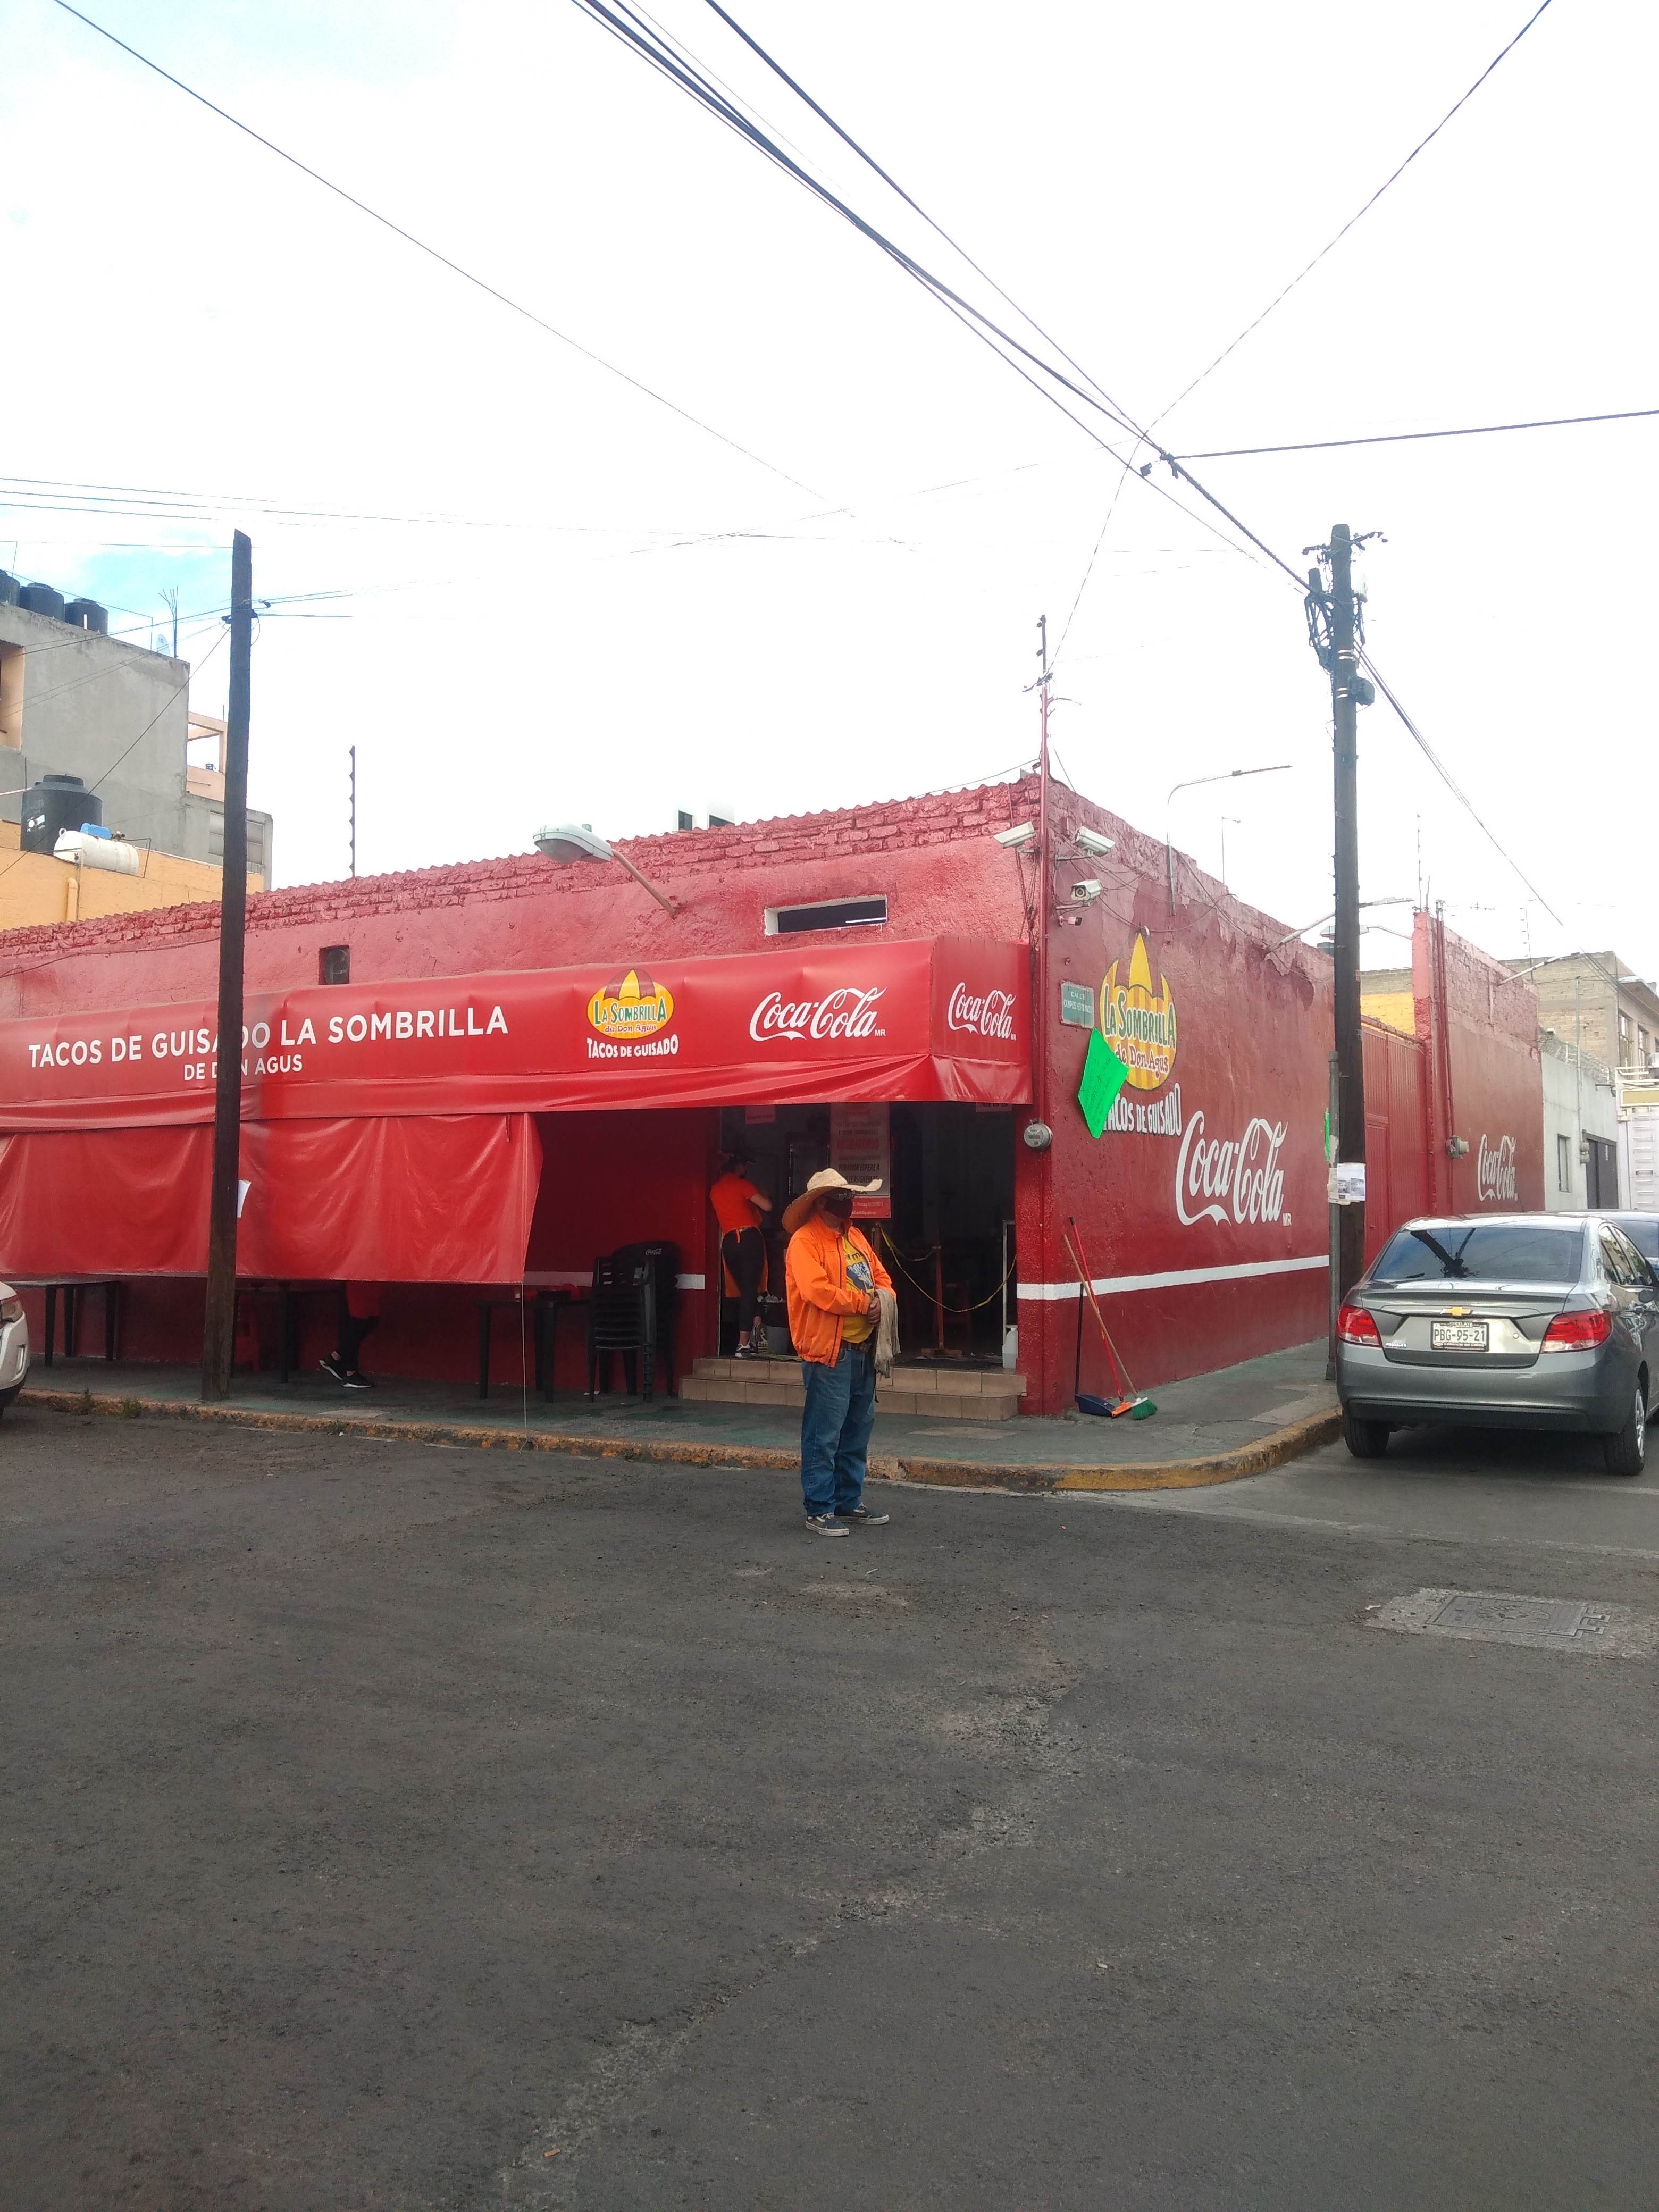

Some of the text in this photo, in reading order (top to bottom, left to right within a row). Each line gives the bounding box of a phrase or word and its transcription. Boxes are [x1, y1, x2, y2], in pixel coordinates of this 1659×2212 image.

[594, 997, 666, 1025] LA SOMBRILLA
[948, 982, 1017, 1039] Coca-Cola
[1070, 991, 1085, 1000] CALLE
[635, 1024, 657, 1033] Agus
[749, 987, 887, 1042] Coca-Cola
[1104, 985, 1176, 1049] LA SOMBRILLA
[29, 1006, 509, 1068] TACOS DE GUISO LA SOMBRILLA
[586, 1034, 678, 1058] TACOS DE GUISADO
[184, 1062, 205, 1081] DE
[254, 1054, 303, 1075] AGUS
[1129, 1045, 1147, 1068] Don
[1148, 1049, 1169, 1079] Agus
[1103, 1093, 1134, 1132] ACOS
[1136, 1104, 1147, 1133] DE
[1147, 1082, 1182, 1136] GUISADO
[1176, 1110, 1288, 1226] Coca-Cola
[1283, 1213, 1292, 1226] MR
[1434, 1329, 1485, 1342] PBG-95-21
